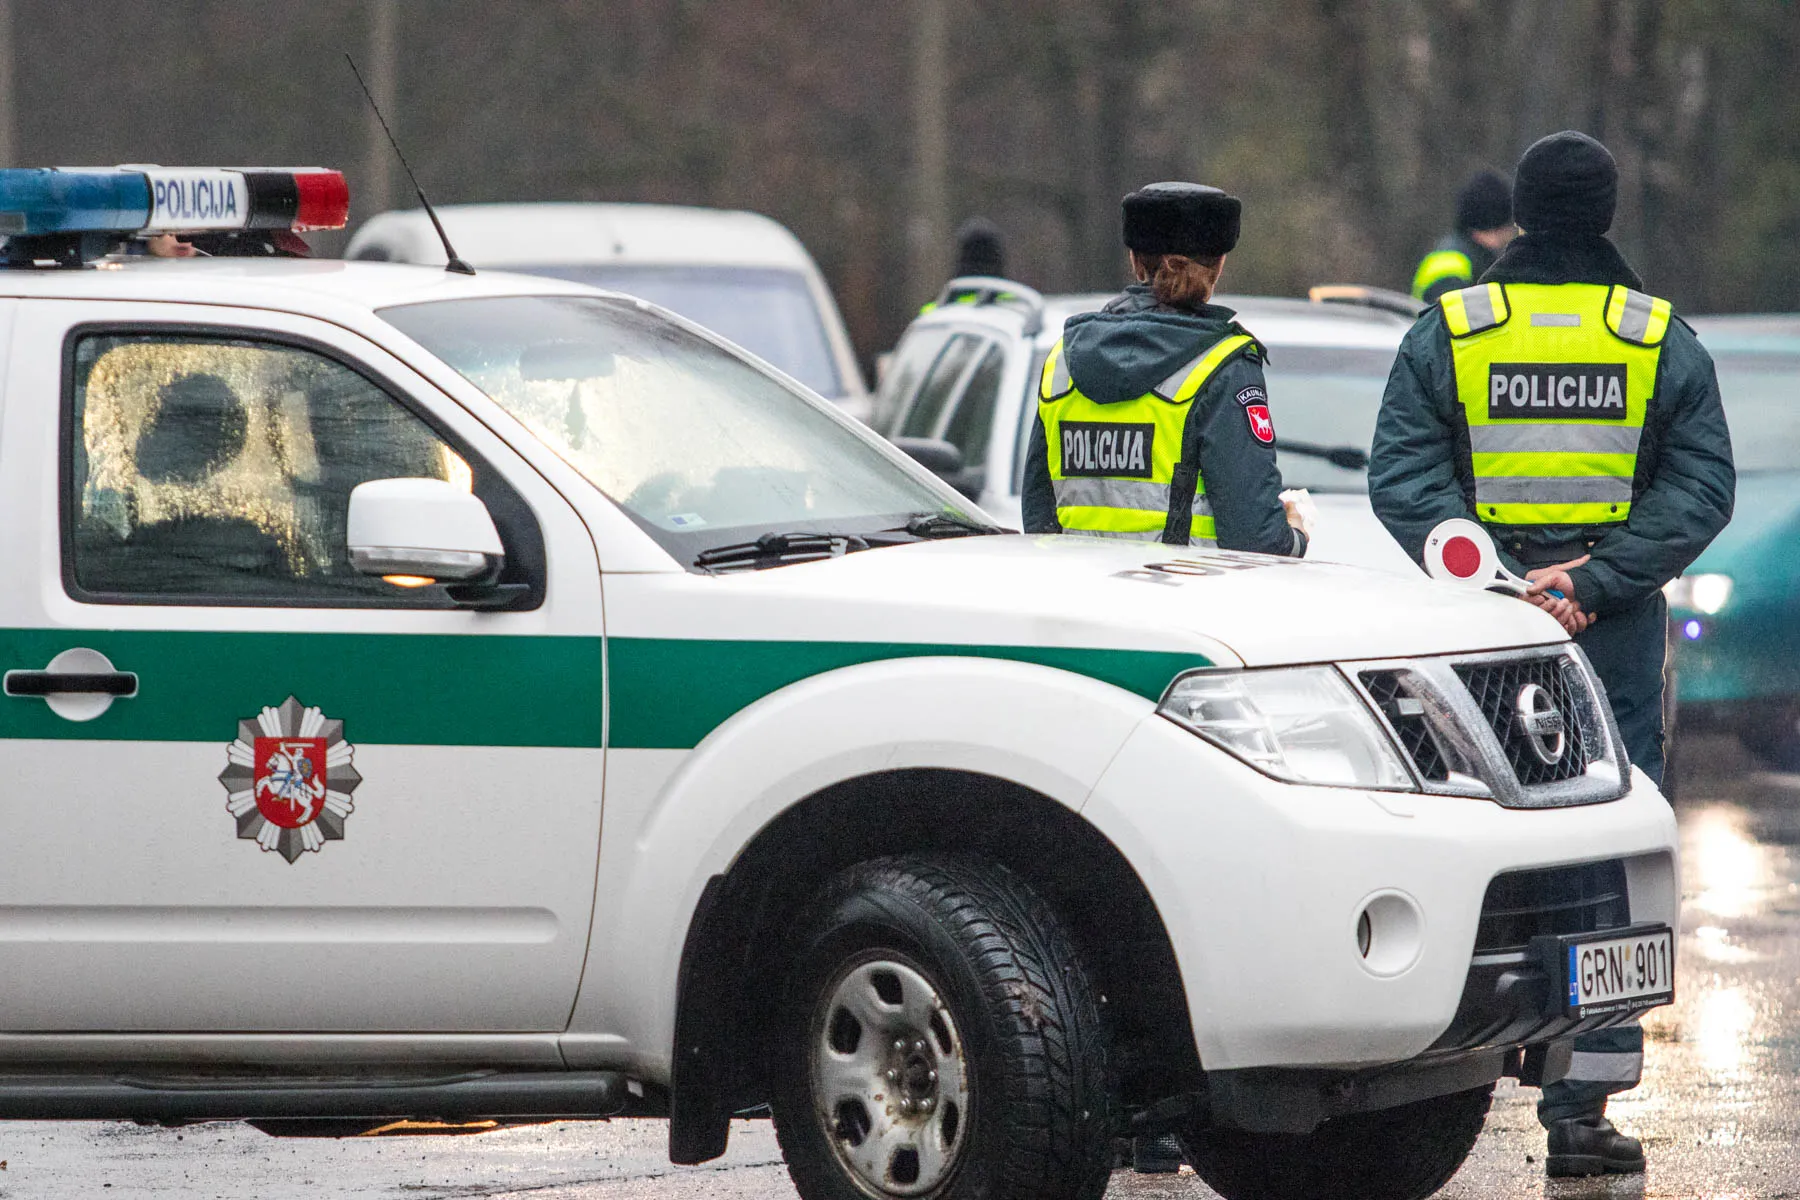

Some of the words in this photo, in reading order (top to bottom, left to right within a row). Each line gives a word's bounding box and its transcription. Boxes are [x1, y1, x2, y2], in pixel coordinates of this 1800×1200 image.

[155, 179, 236, 219] POLICIJA
[1490, 374, 1624, 408] POLICIJA
[1063, 429, 1145, 470] POLICIJA
[1581, 945, 1624, 997] GRN
[1636, 939, 1667, 990] 901
